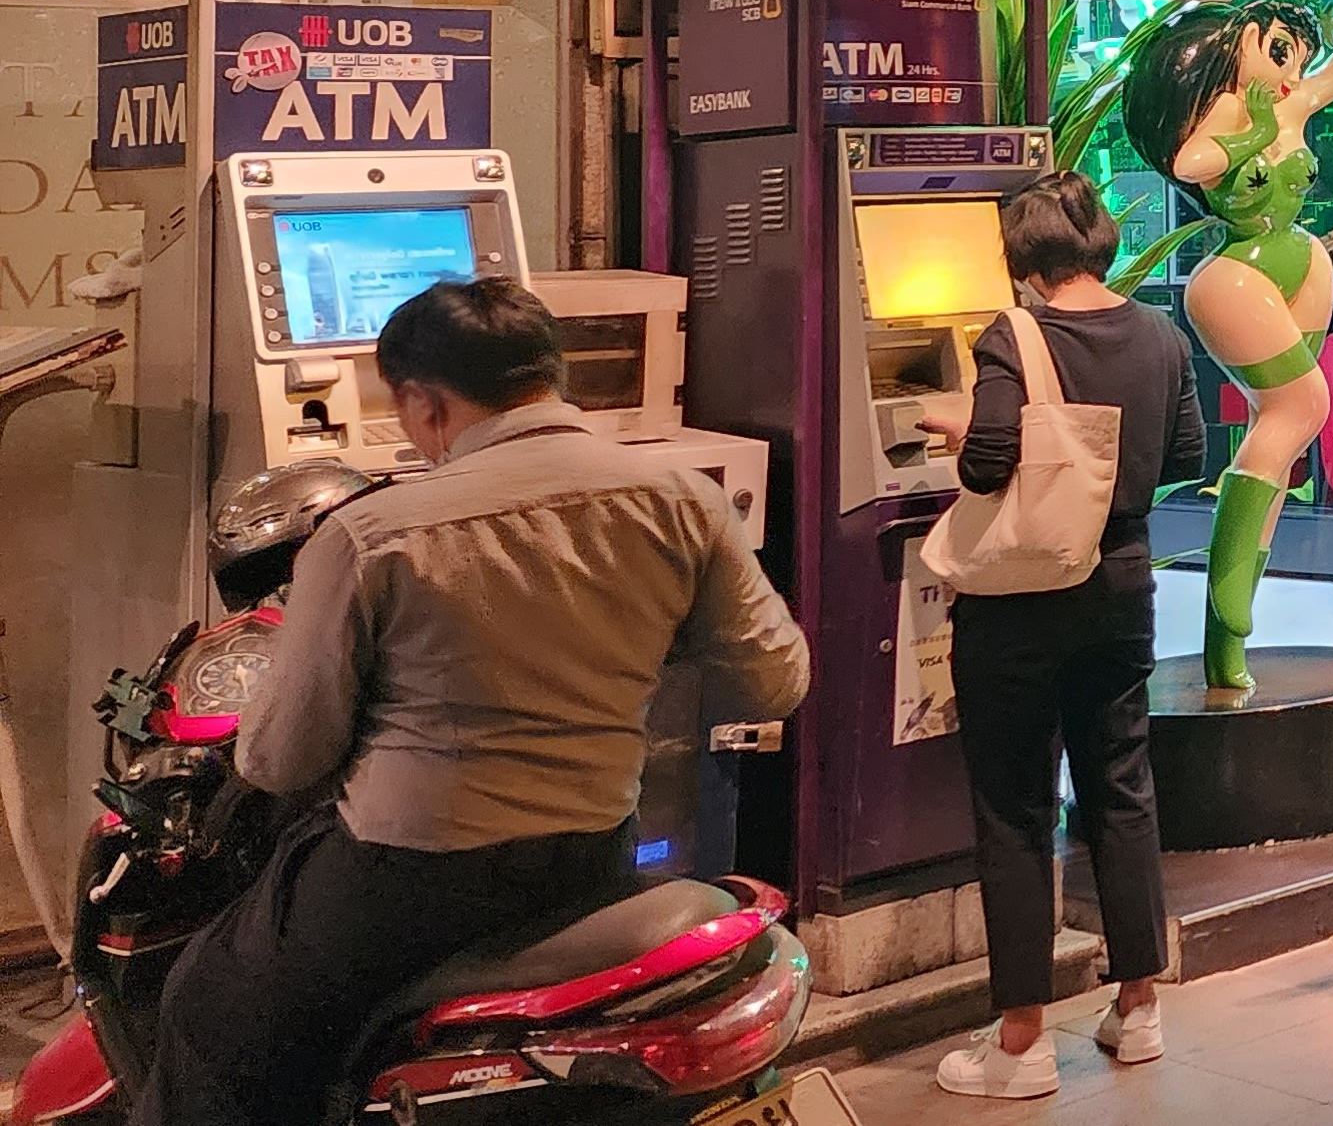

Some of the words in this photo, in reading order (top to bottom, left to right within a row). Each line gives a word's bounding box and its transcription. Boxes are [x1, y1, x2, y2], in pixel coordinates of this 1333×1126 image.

[742, 7, 761, 21] SCB
[141, 21, 173, 50] UOB
[337, 19, 413, 47] UOB
[242, 45, 297, 79] TAX
[823, 42, 904, 76] ATM
[907, 64, 919, 75] 24
[111, 82, 187, 148] ATM
[262, 81, 447, 141] ATM
[689, 89, 751, 114] EASYBANK
[291, 221, 323, 233] UOB
[918, 655, 944, 669] VISA
[449, 1062, 514, 1086] MOOVE
